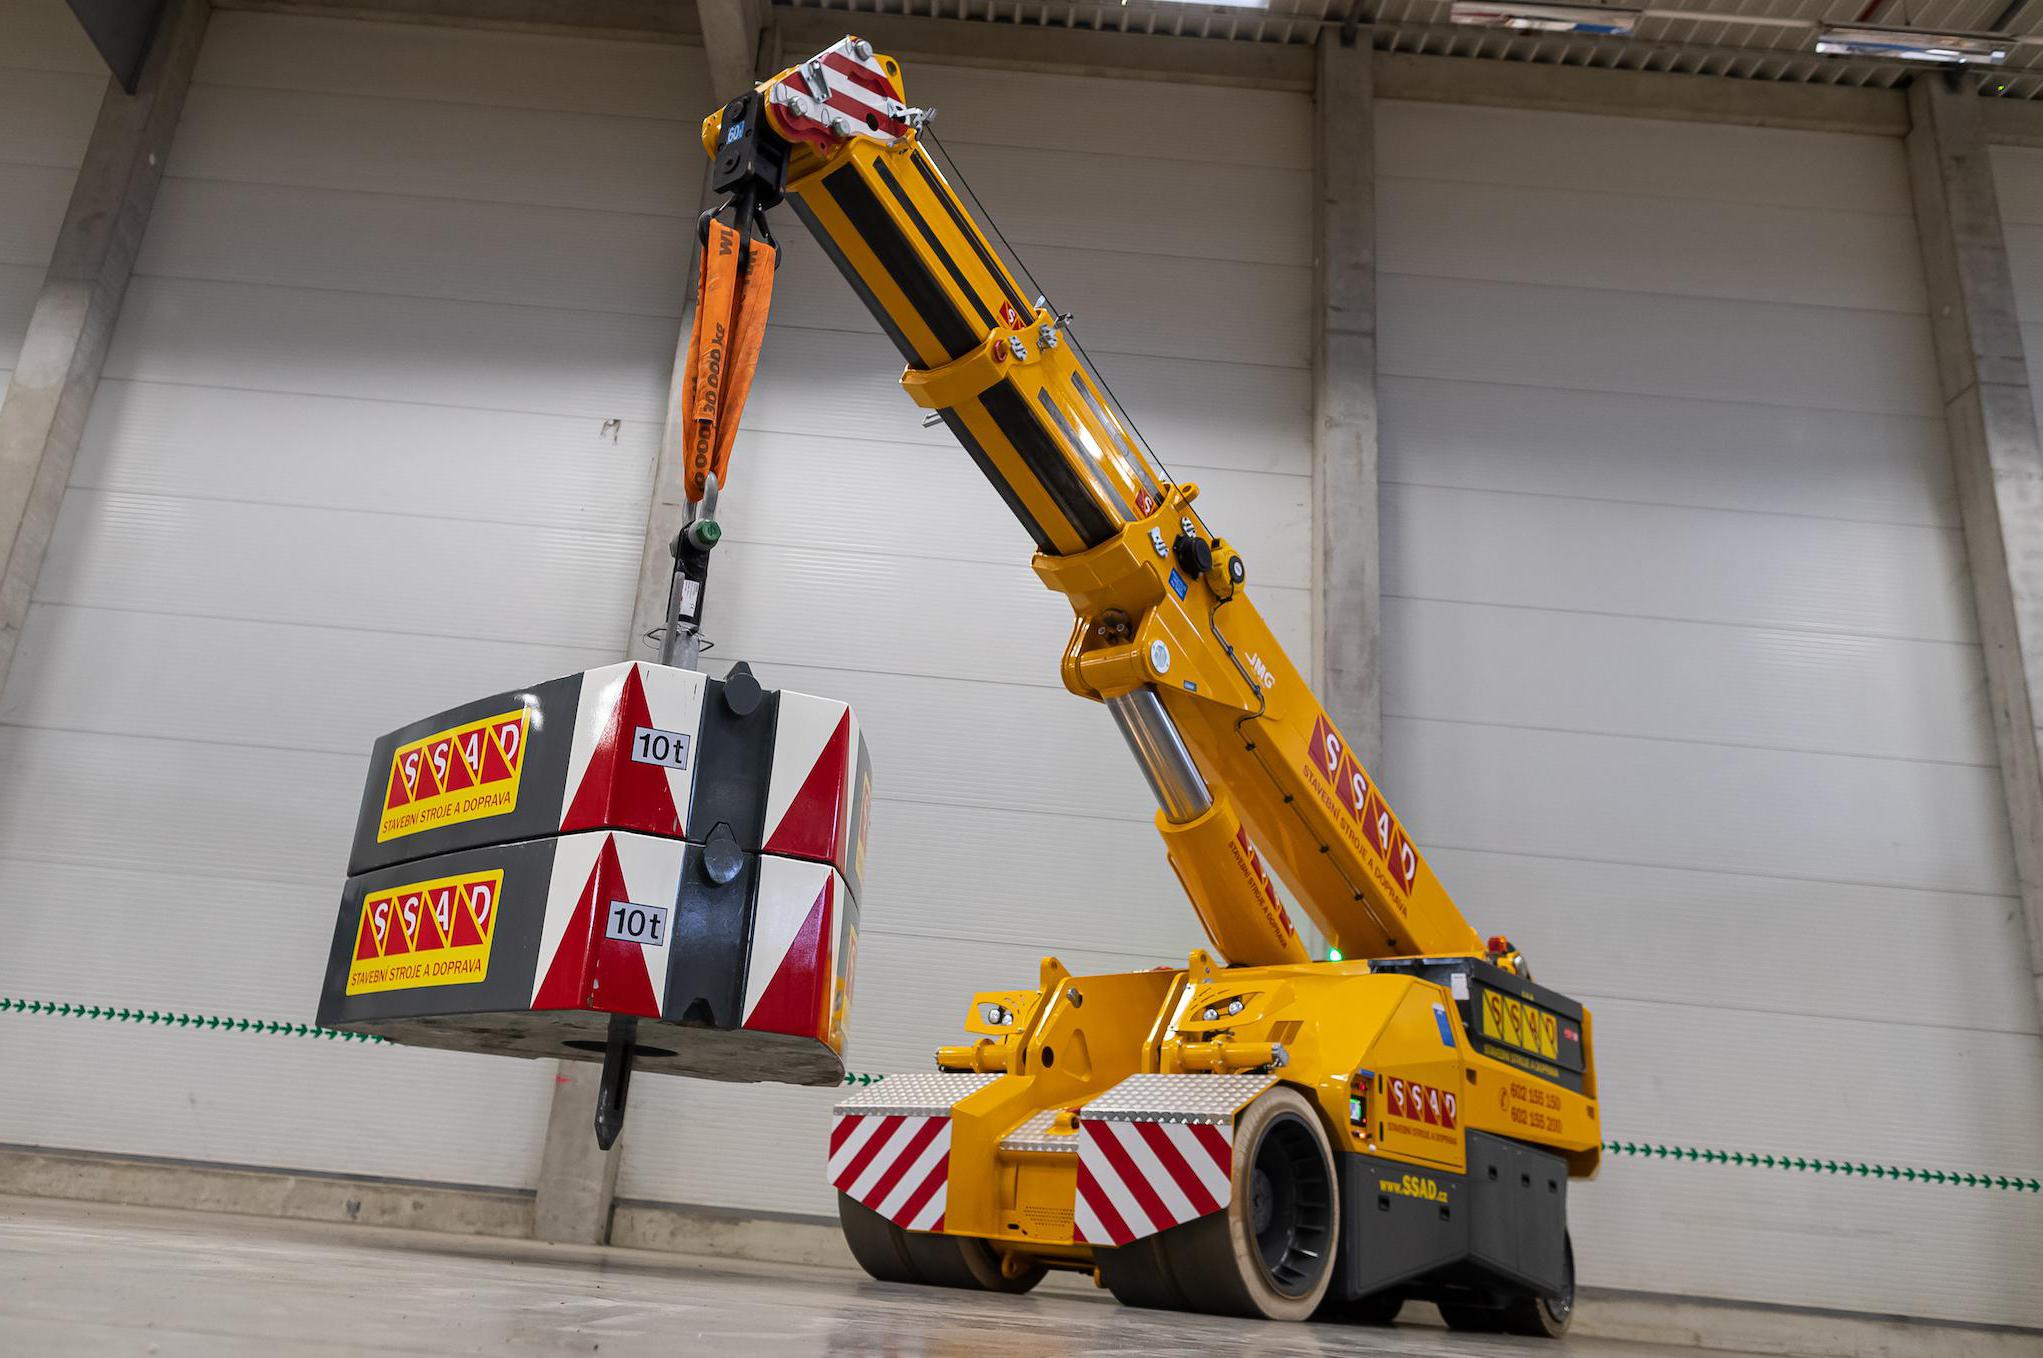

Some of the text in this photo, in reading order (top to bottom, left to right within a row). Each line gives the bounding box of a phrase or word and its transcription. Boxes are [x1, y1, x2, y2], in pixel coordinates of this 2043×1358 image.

[707, 348, 721, 389] 000
[1244, 652, 1276, 689] JMG
[405, 723, 520, 789] SSAD
[382, 791, 511, 834] STAVEBNÍ STROJE A DOPRAVA
[1326, 733, 1416, 881] SSAD
[1303, 765, 1408, 919] STAVEBNÍ STROJE A DOPRAVA
[374, 885, 491, 941] SSAD
[351, 958, 482, 987] STAVEBNÍ STROJE A DOPRAVA
[1491, 996, 1556, 1045] SSAD
[1393, 1079, 1456, 1119] SSAD
[1379, 1174, 1449, 1203] www.SSAD.cz
